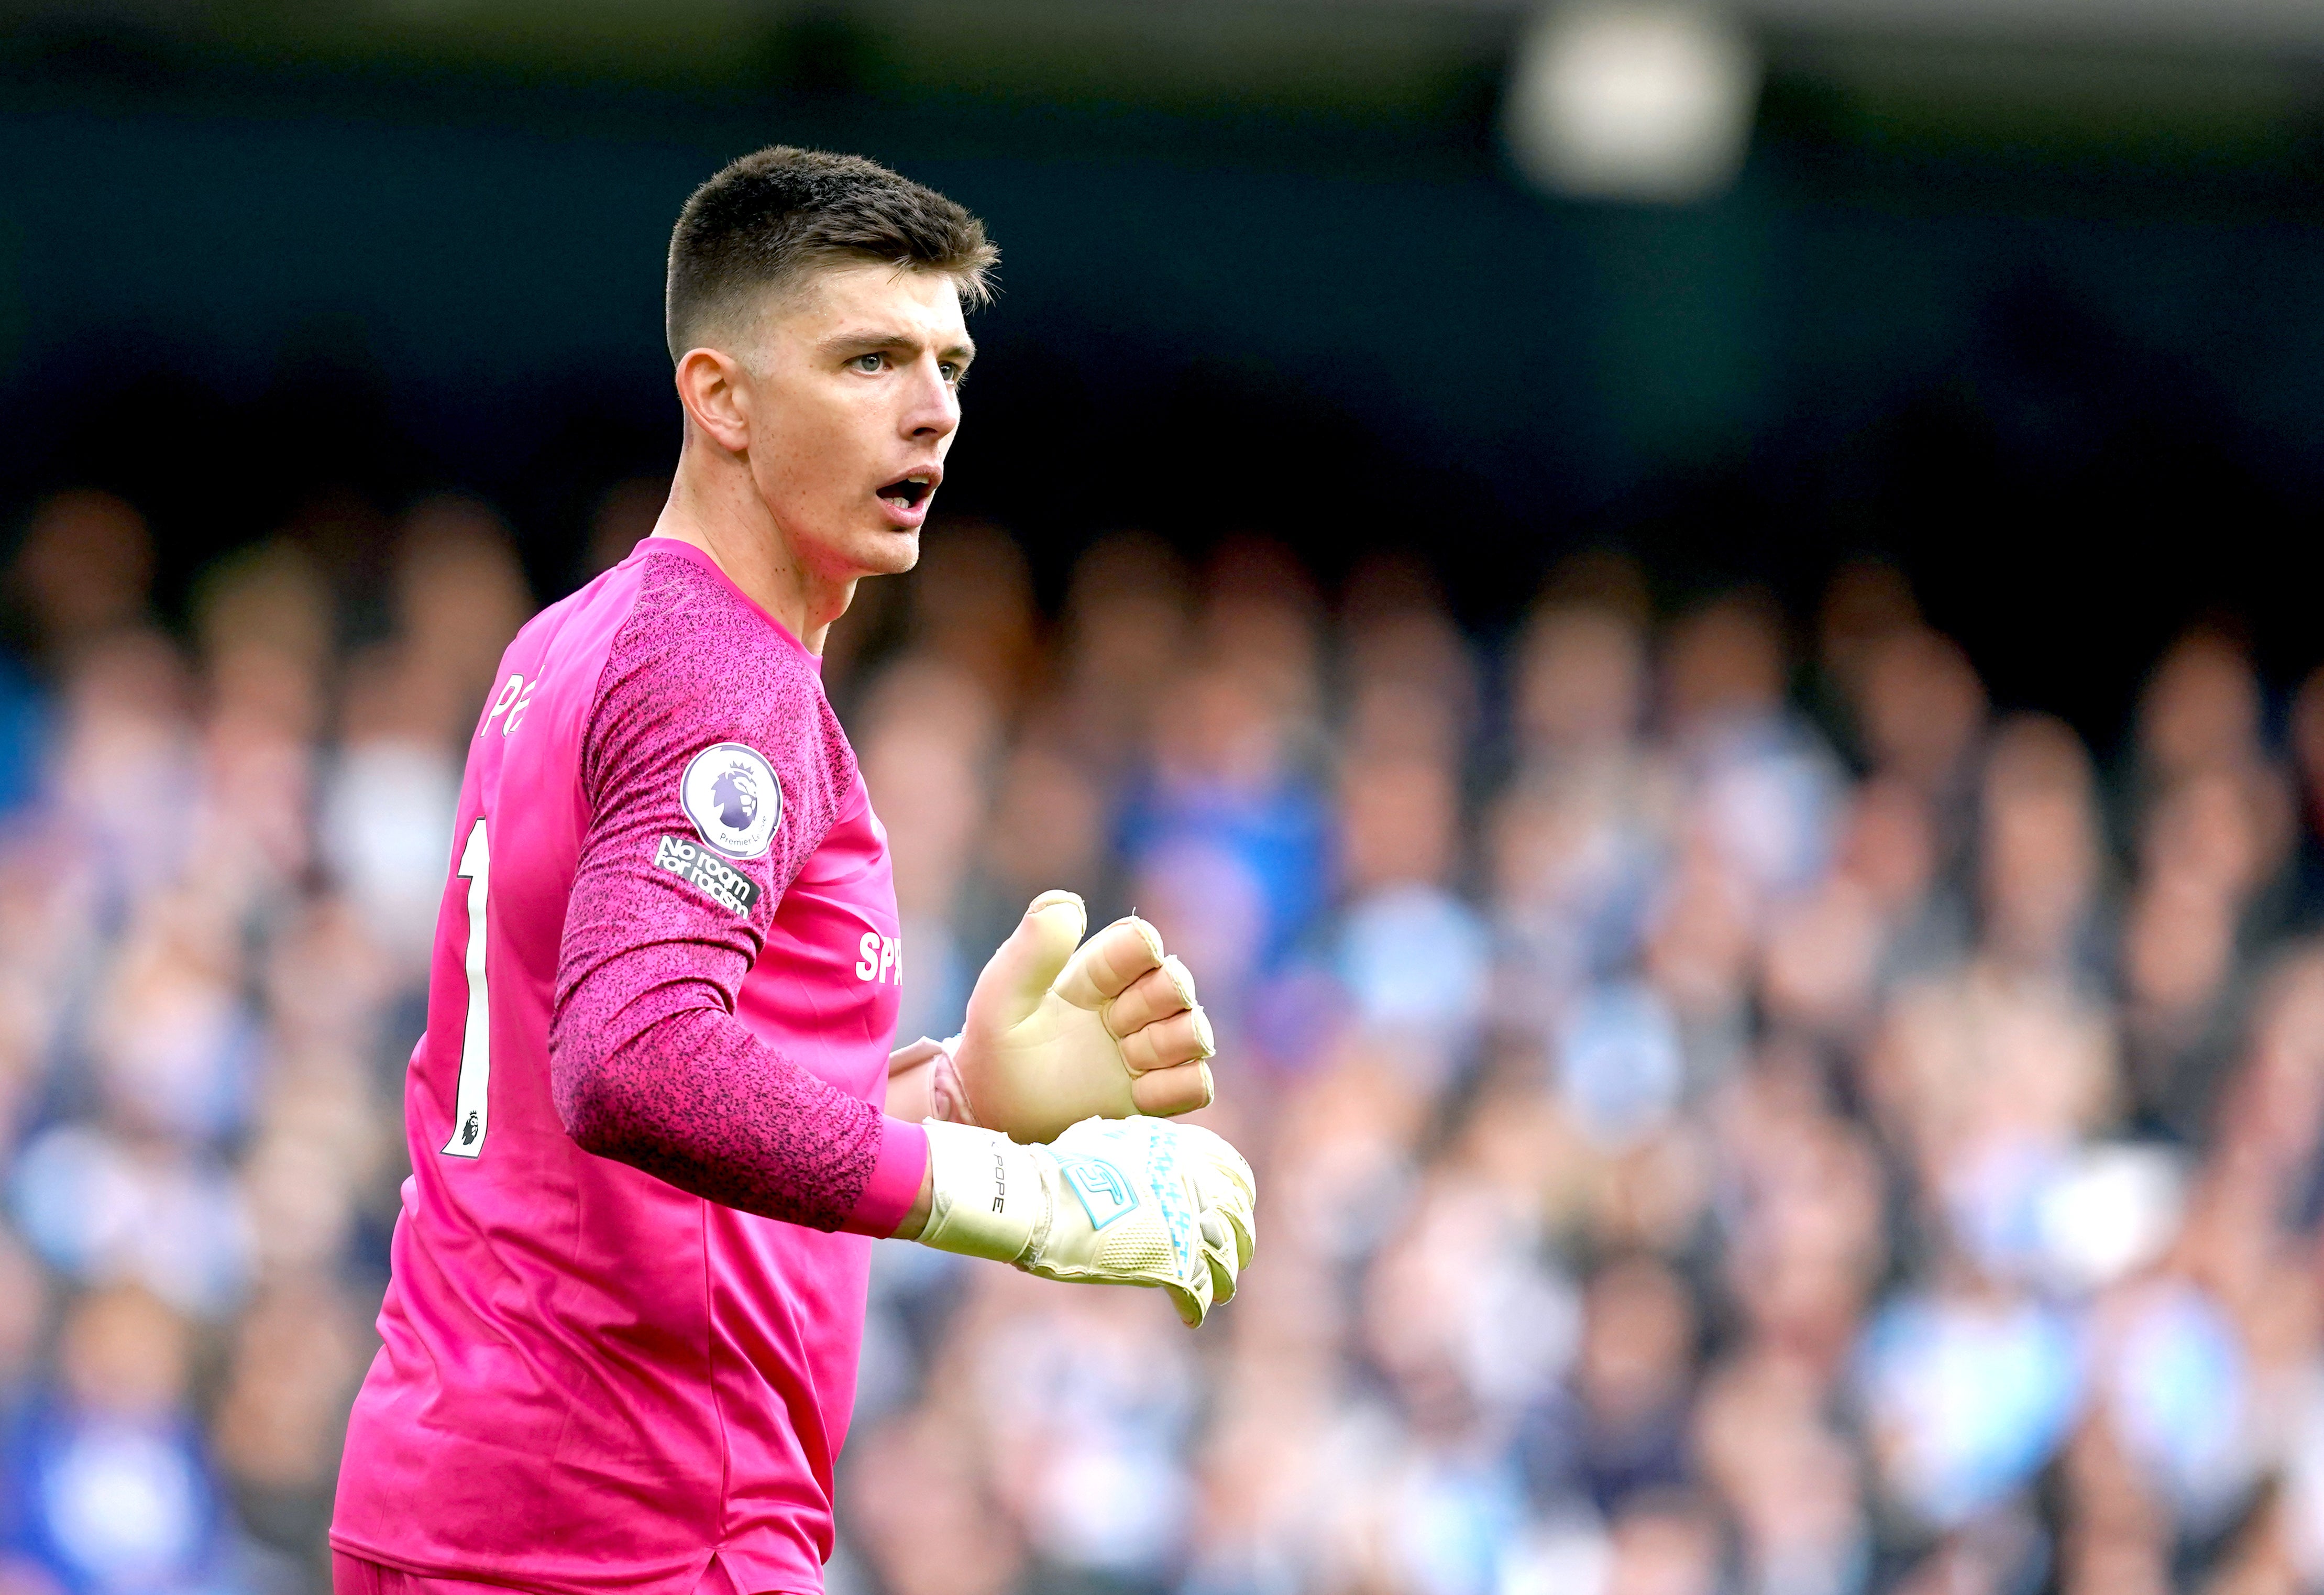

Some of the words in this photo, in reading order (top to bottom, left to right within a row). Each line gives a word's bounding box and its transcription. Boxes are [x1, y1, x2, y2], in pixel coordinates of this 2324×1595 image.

[658, 835, 696, 860] No
[697, 852, 751, 901] room
[720, 832, 751, 846] Premier
[439, 814, 490, 1160] 1
[992, 1154, 1005, 1213] POPE
